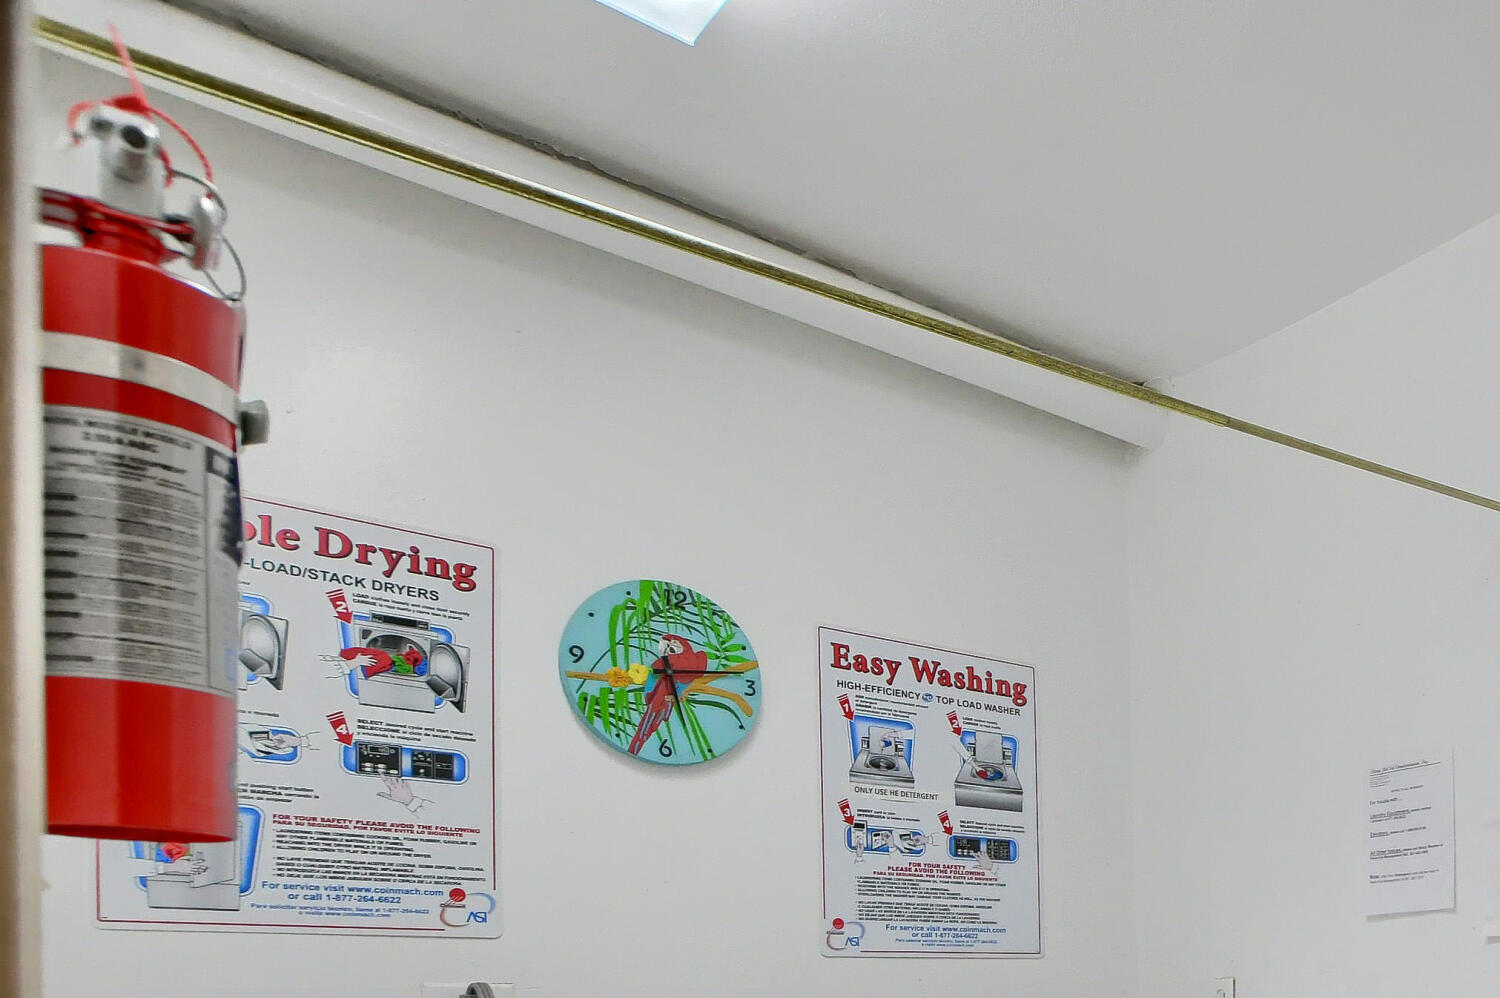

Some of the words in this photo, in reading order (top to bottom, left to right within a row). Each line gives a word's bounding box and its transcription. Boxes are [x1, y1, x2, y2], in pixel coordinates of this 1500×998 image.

[314, 526, 477, 592] Drying
[371, 579, 440, 602] DRYERS
[335, 601, 347, 612] 2
[664, 589, 687, 610] 12
[569, 645, 584, 663] 9
[830, 642, 902, 685] Easy
[908, 656, 1027, 707] Washing
[744, 680, 756, 697] 3
[836, 680, 922, 701] HIGH-EFFICIENCY
[936, 695, 955, 706] TOP
[957, 699, 982, 710] LOAD
[984, 703, 1021, 717] WASHER
[337, 723, 348, 734] 4
[951, 719, 959, 728] 2
[659, 739, 673, 757] 6
[854, 786, 873, 794] ONLY
[900, 791, 938, 800] DETERGENT
[356, 819, 387, 827] PLEASE
[261, 881, 280, 889] For
[283, 883, 320, 891] service
[323, 883, 345, 891] visit
[347, 886, 444, 896] www.coinmach.com
[303, 893, 322, 901] call
[326, 894, 401, 904] 1-877-264-6622
[886, 923, 898, 931] For
[942, 926, 1006, 934] www.coinmach.com
